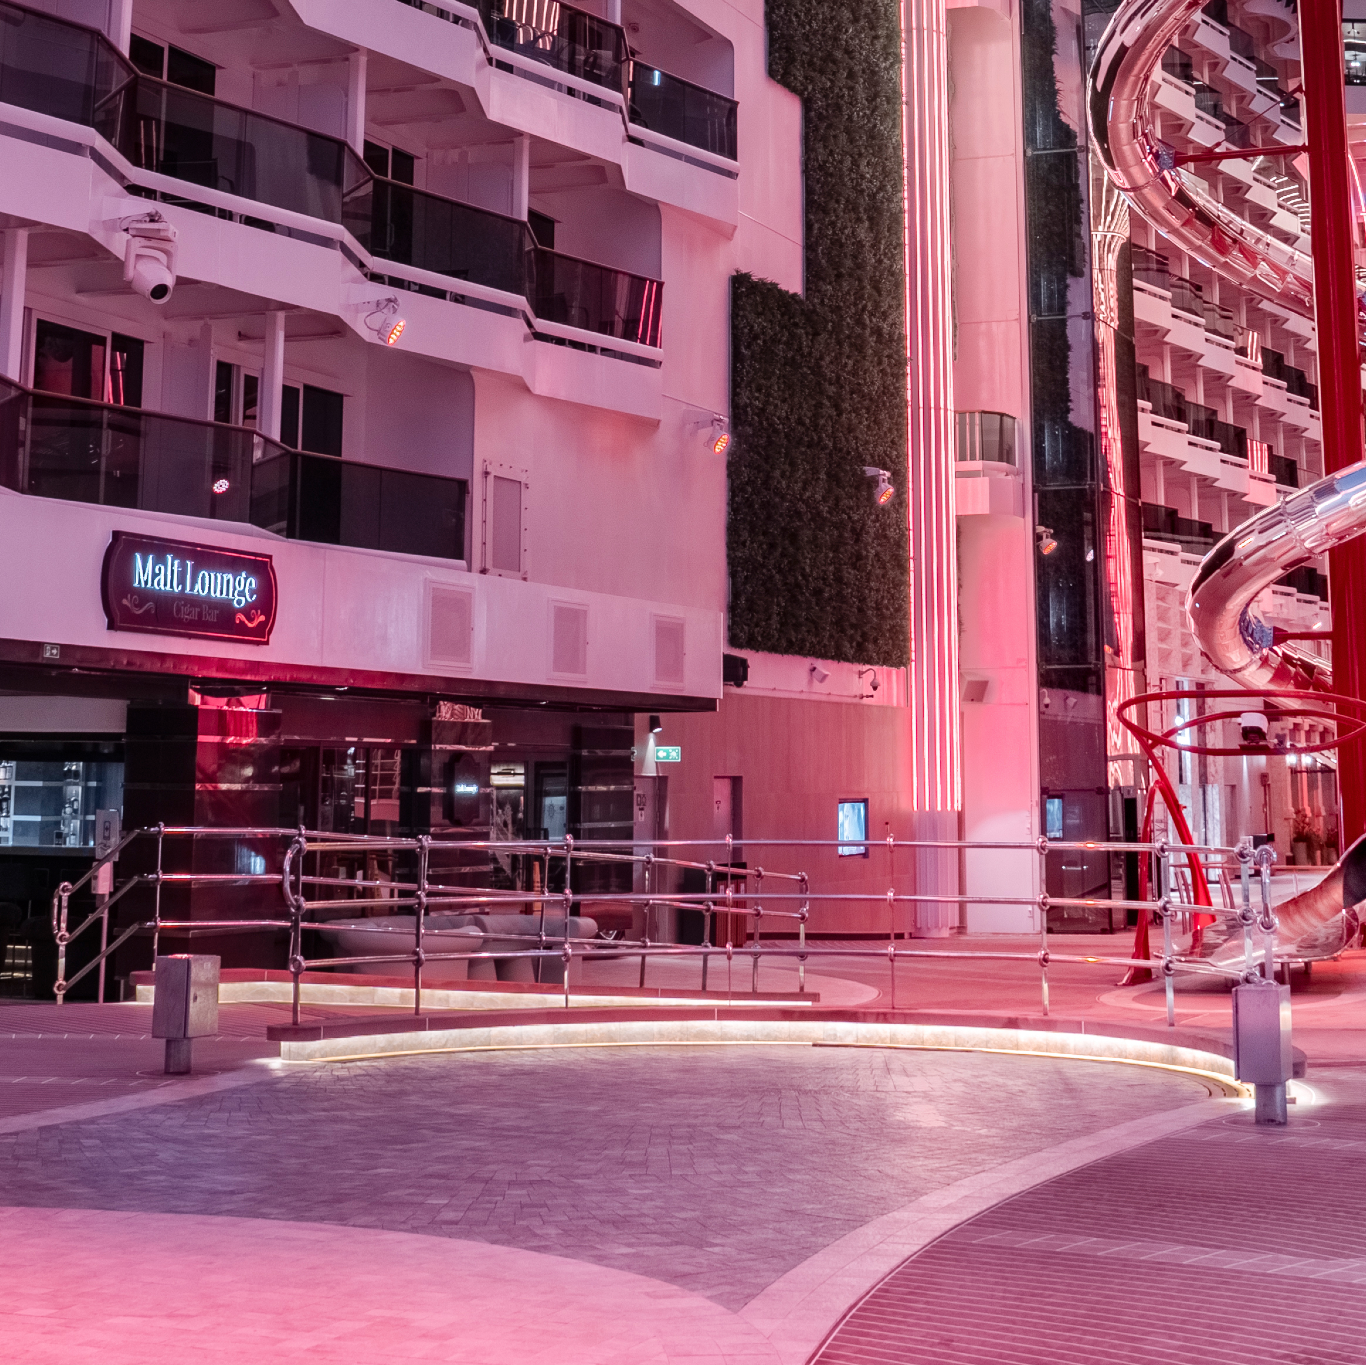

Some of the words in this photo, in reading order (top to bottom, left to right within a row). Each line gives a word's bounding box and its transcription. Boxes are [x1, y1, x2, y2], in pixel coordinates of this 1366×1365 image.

[133, 552, 182, 592] Malt
[185, 560, 258, 608] Lounge
[173, 600, 200, 623] Cigar
[202, 604, 219, 622] Bar
